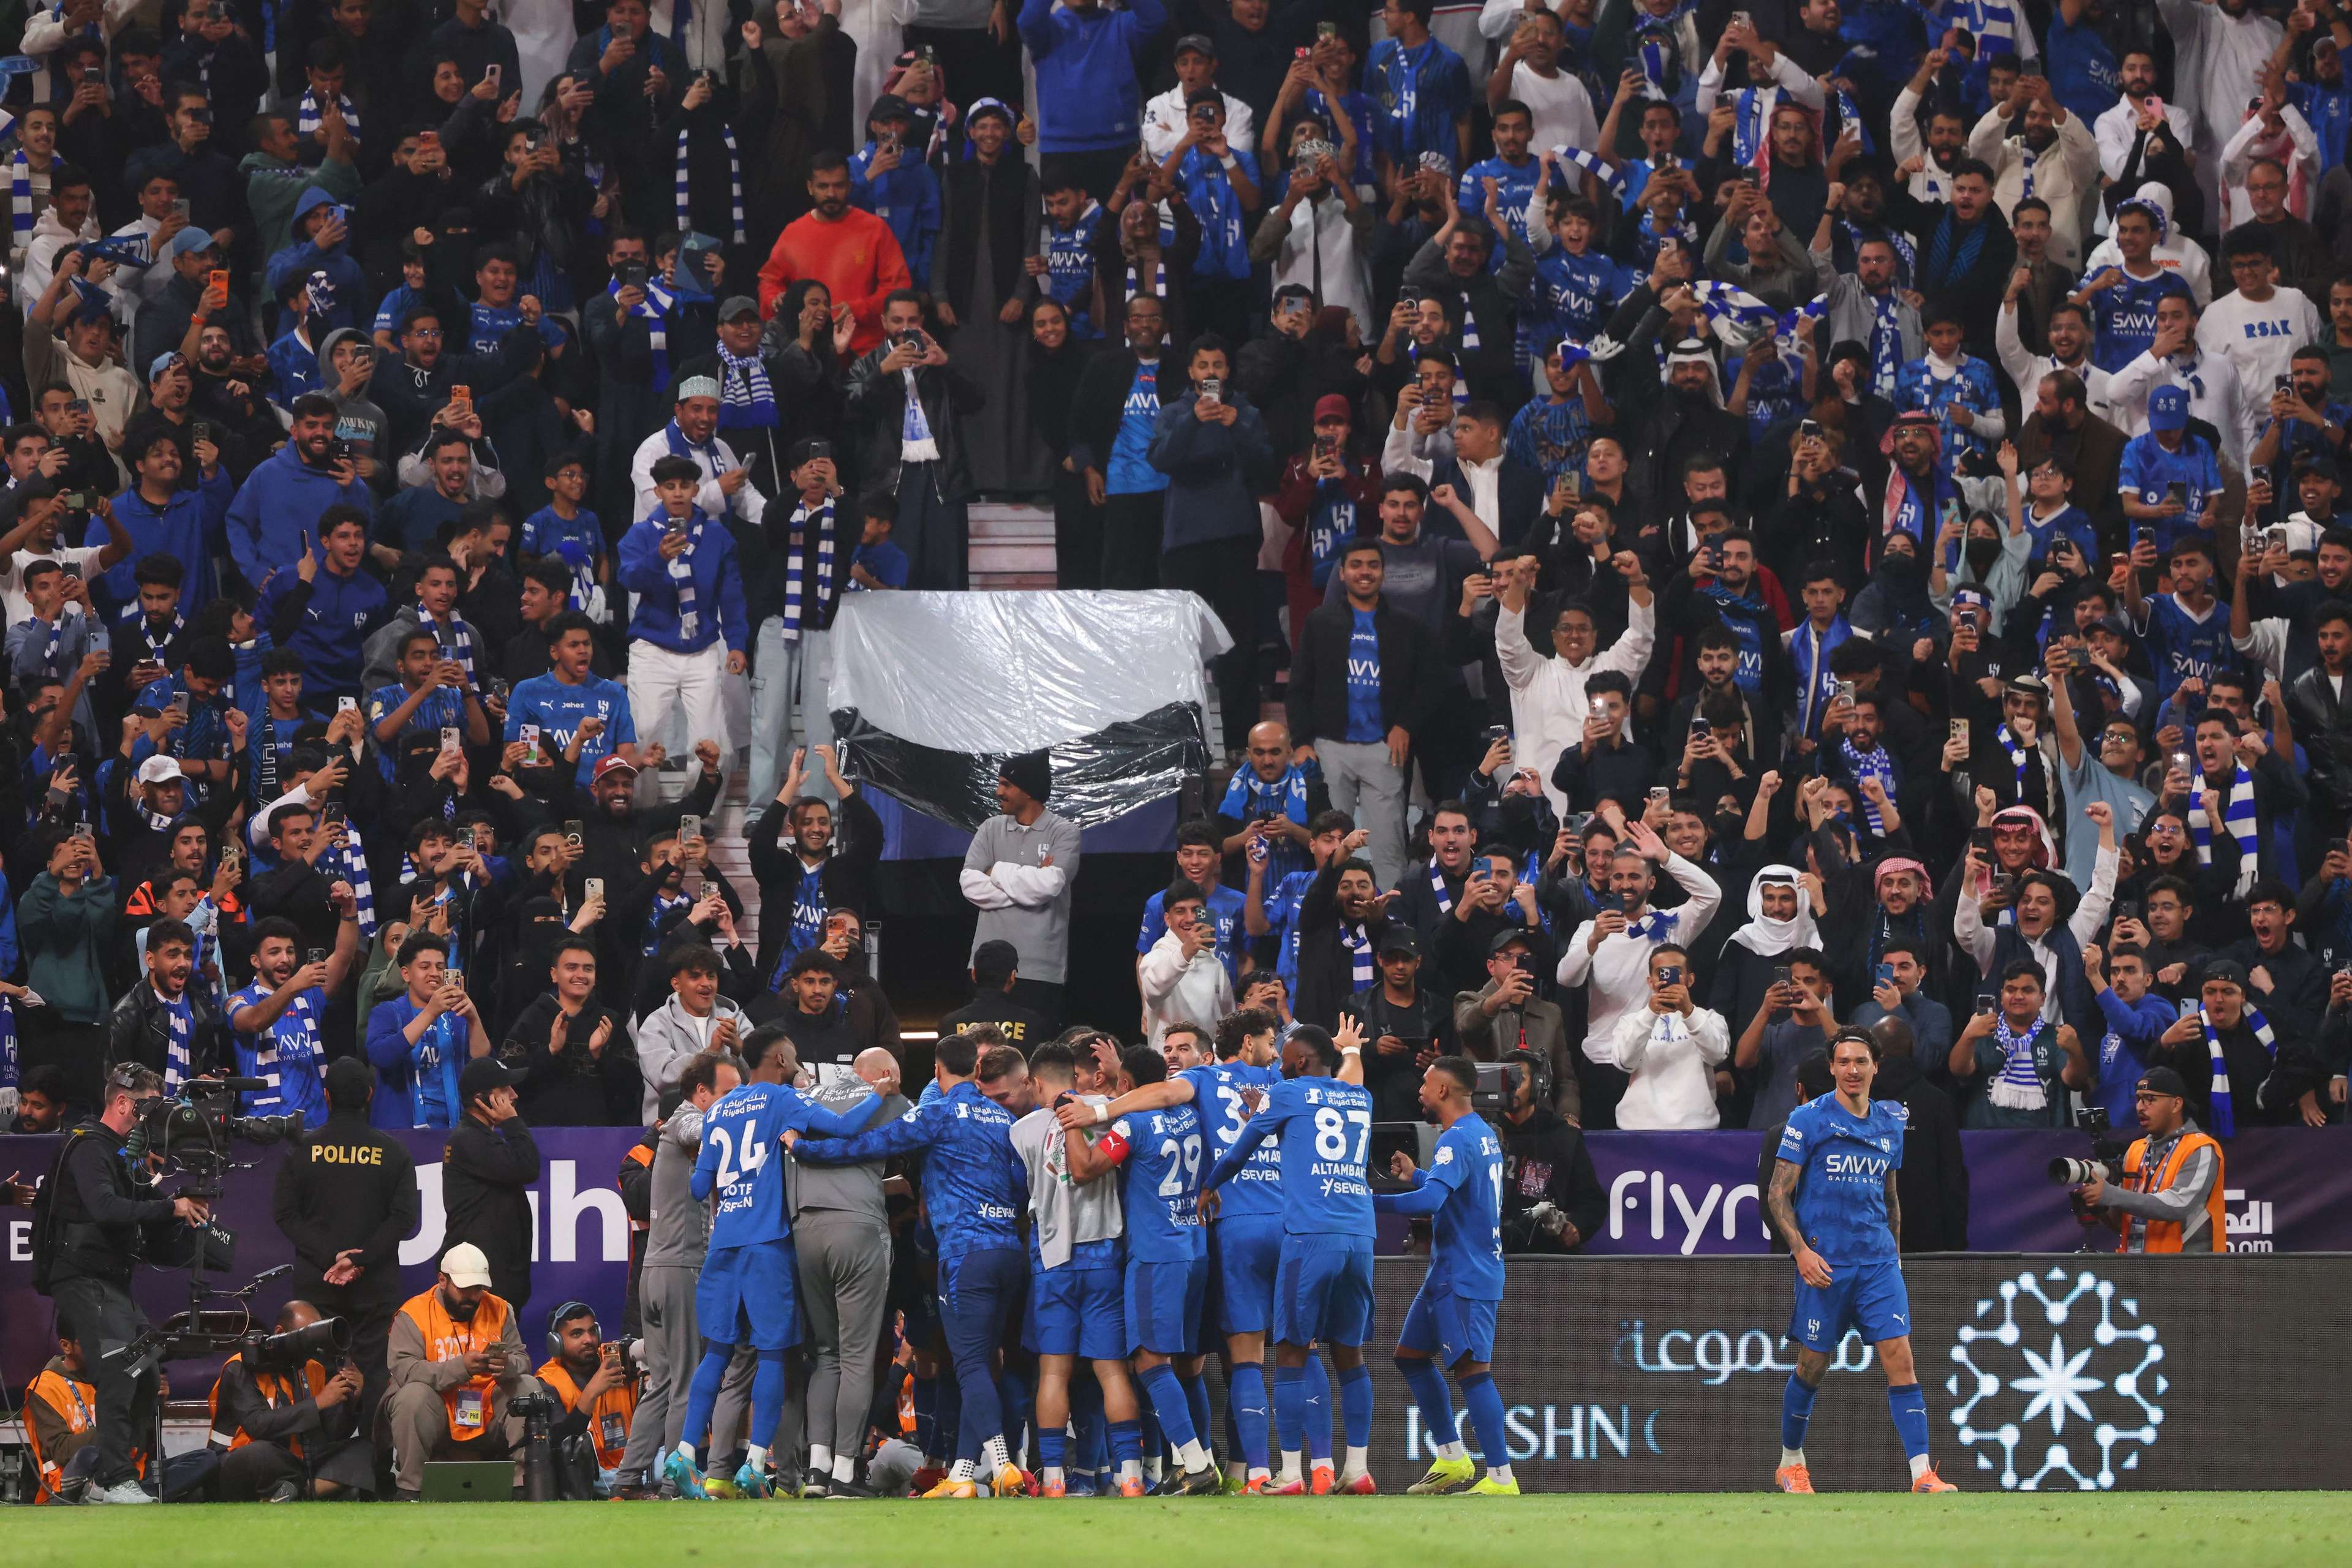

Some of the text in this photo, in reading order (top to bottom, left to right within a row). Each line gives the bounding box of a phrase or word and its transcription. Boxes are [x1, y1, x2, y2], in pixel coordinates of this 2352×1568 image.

[2113, 312, 2157, 330] SAVV
[2244, 320, 2293, 338] RSAK
[821, 1093, 846, 1102] Riyad
[1327, 1098, 1368, 1107] Riyad Bank
[722, 1102, 766, 1117] Riyad Bank
[974, 1113, 995, 1124] Riyad
[1314, 1107, 1371, 1164] 87
[311, 1145, 383, 1166] POLICE
[709, 1120, 769, 1188] 24
[1158, 1134, 1202, 1197] 29
[1825, 1155, 1890, 1177] SAVVY
[1169, 1197, 1197, 1213] SALEM
